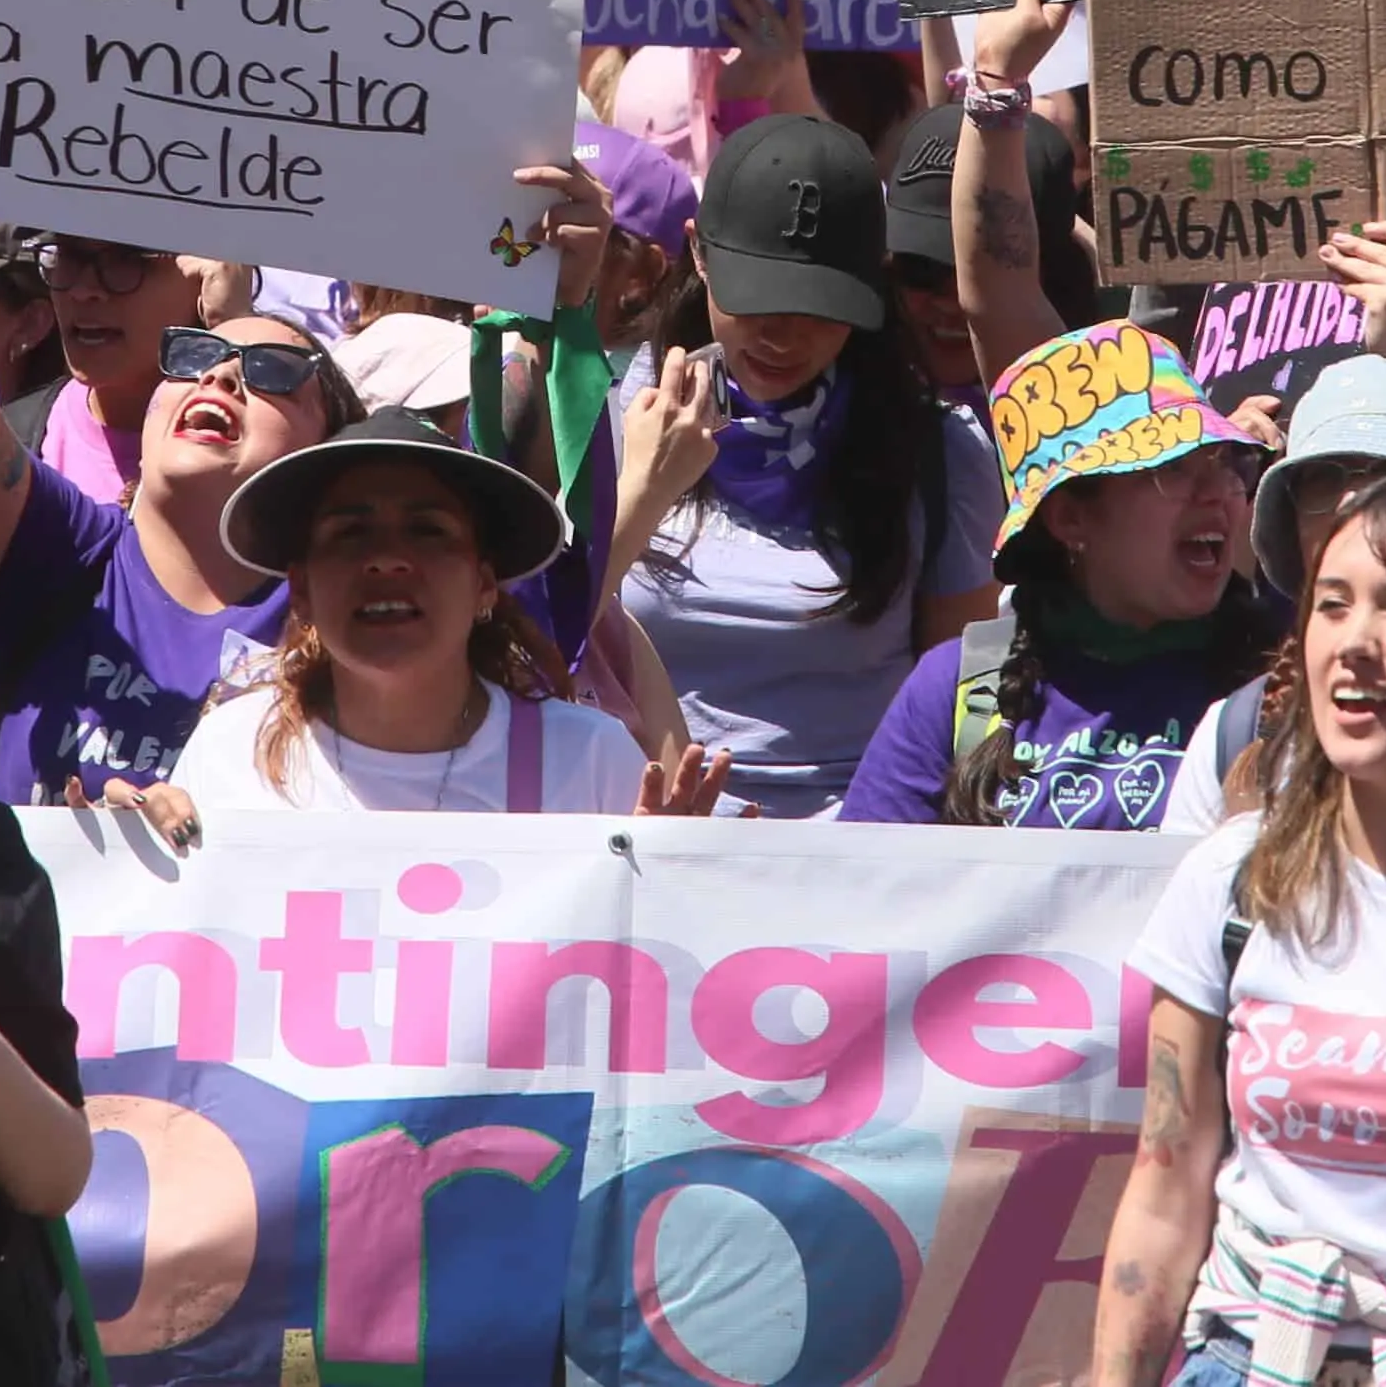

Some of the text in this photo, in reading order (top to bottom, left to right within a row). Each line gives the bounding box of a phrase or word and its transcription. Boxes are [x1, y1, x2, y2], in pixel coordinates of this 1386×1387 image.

[84, 32, 431, 135] maestra
[1128, 43, 1328, 109] como
[991, 324, 1154, 474] DREW
[1062, 406, 1204, 474] DREW
[84, 653, 158, 707] POR
[1055, 726, 1140, 758] ALZO
